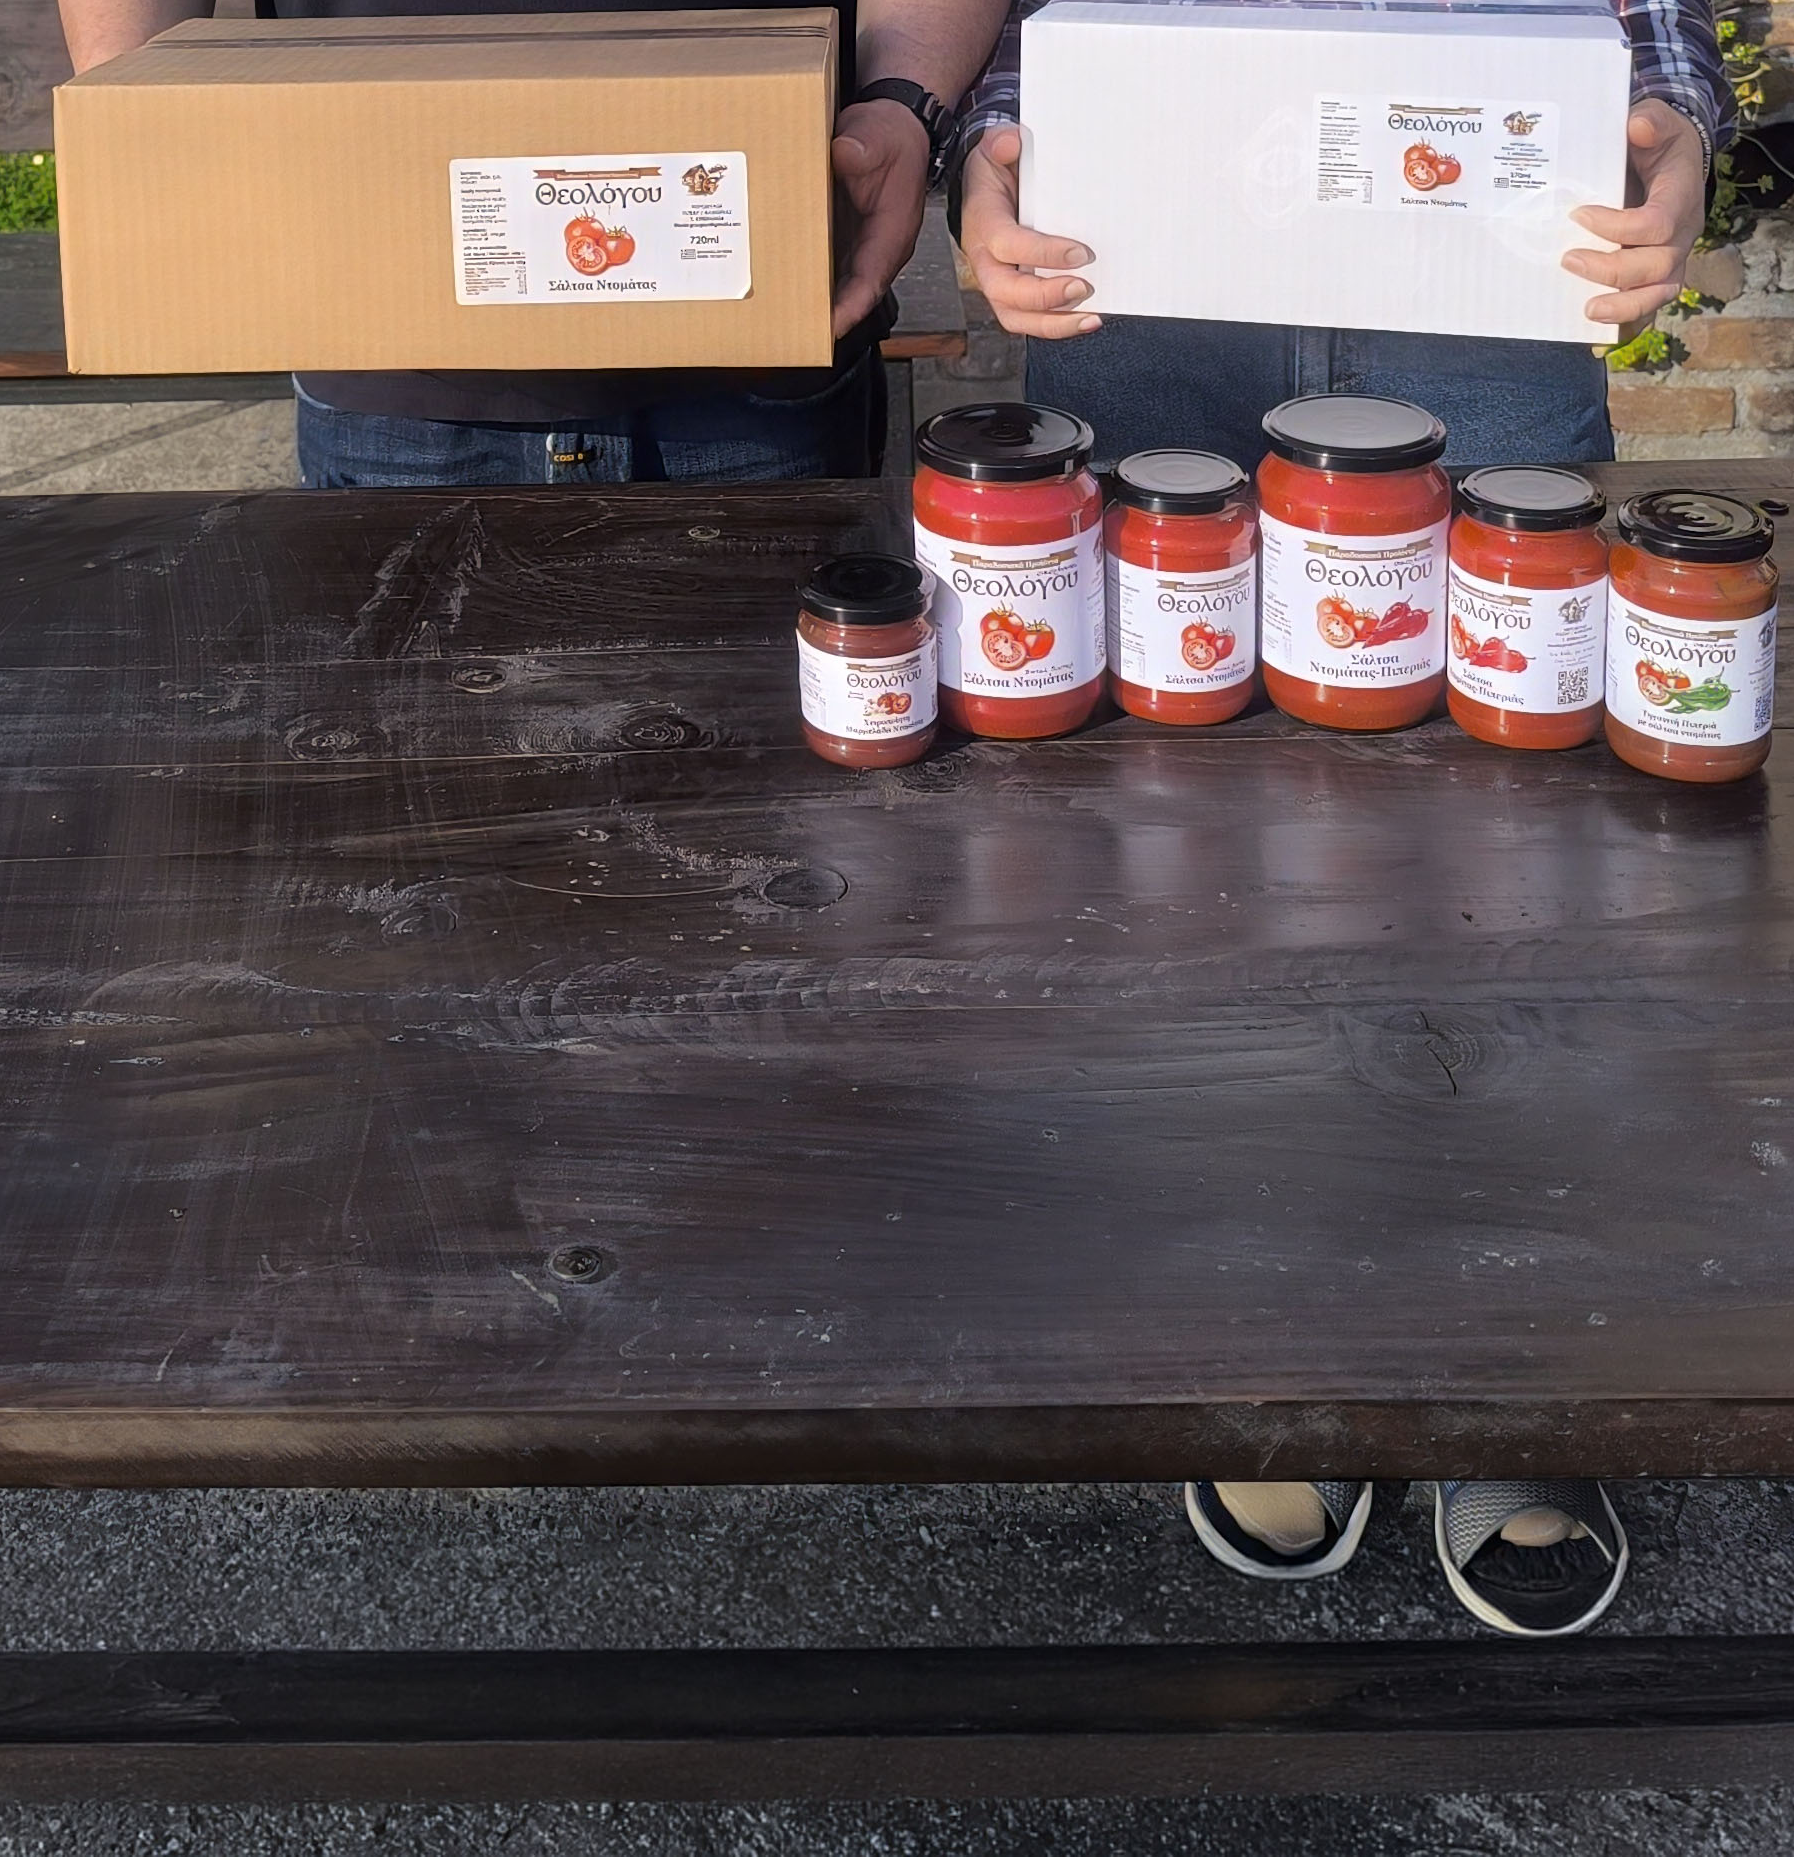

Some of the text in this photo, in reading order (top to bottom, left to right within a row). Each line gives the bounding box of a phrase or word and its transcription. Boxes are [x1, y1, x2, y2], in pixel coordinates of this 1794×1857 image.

[1387, 113, 1482, 136] Θεολόγου
[535, 182, 662, 209] Θεολόγου
[689, 235, 719, 245] 720ml
[548, 278, 657, 292] Σάλτσα Ντομάτας
[952, 568, 1079, 600] Θεολόγου
[1305, 558, 1433, 591] Θεολόγου
[1157, 586, 1250, 614] Θεολόγου
[1625, 625, 1737, 668] Θεολόγου
[1350, 653, 1400, 666] Σάλτσα
[846, 668, 922, 689] Θεολόγου
[963, 671, 1074, 689] Σάλτσα Ντομάτας
